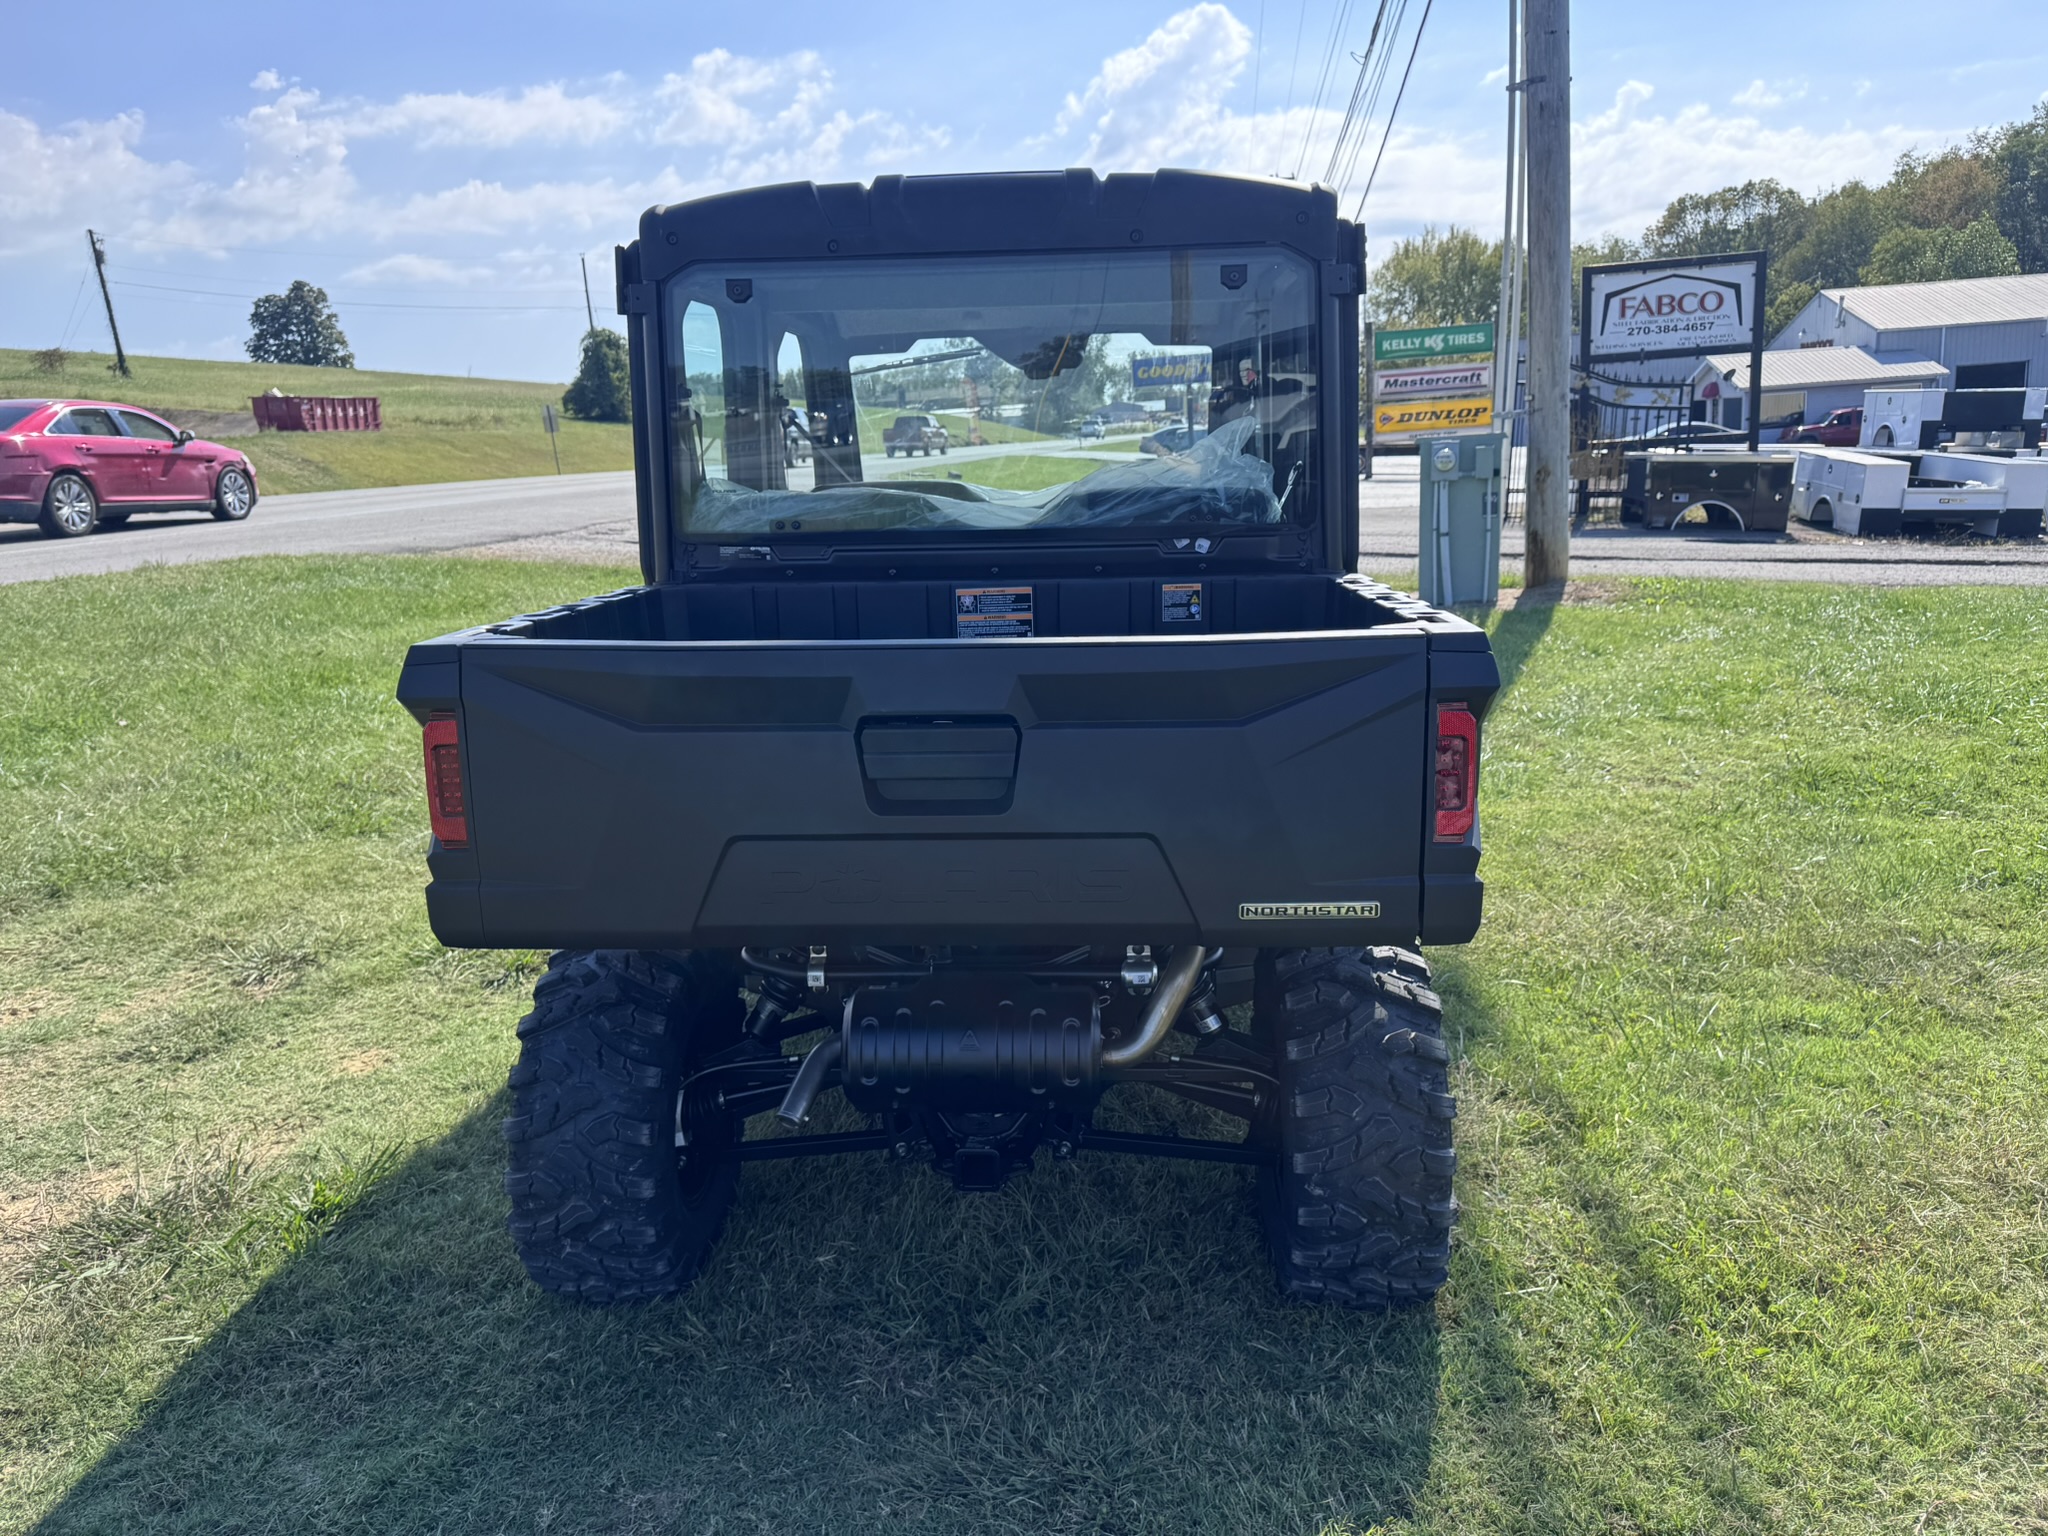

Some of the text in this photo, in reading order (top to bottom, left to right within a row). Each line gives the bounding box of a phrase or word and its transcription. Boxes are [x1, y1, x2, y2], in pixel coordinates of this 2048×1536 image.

[1618, 290, 1725, 320] FABCO
[1627, 322, 1715, 336] 270-384-4657
[1382, 337, 1422, 351] KELLY
[1447, 332, 1485, 346] TIRES
[1384, 372, 1482, 389] Mastercraft
[1397, 407, 1488, 424] DUNLOP
[1244, 905, 1374, 917] NORTHSTAR
